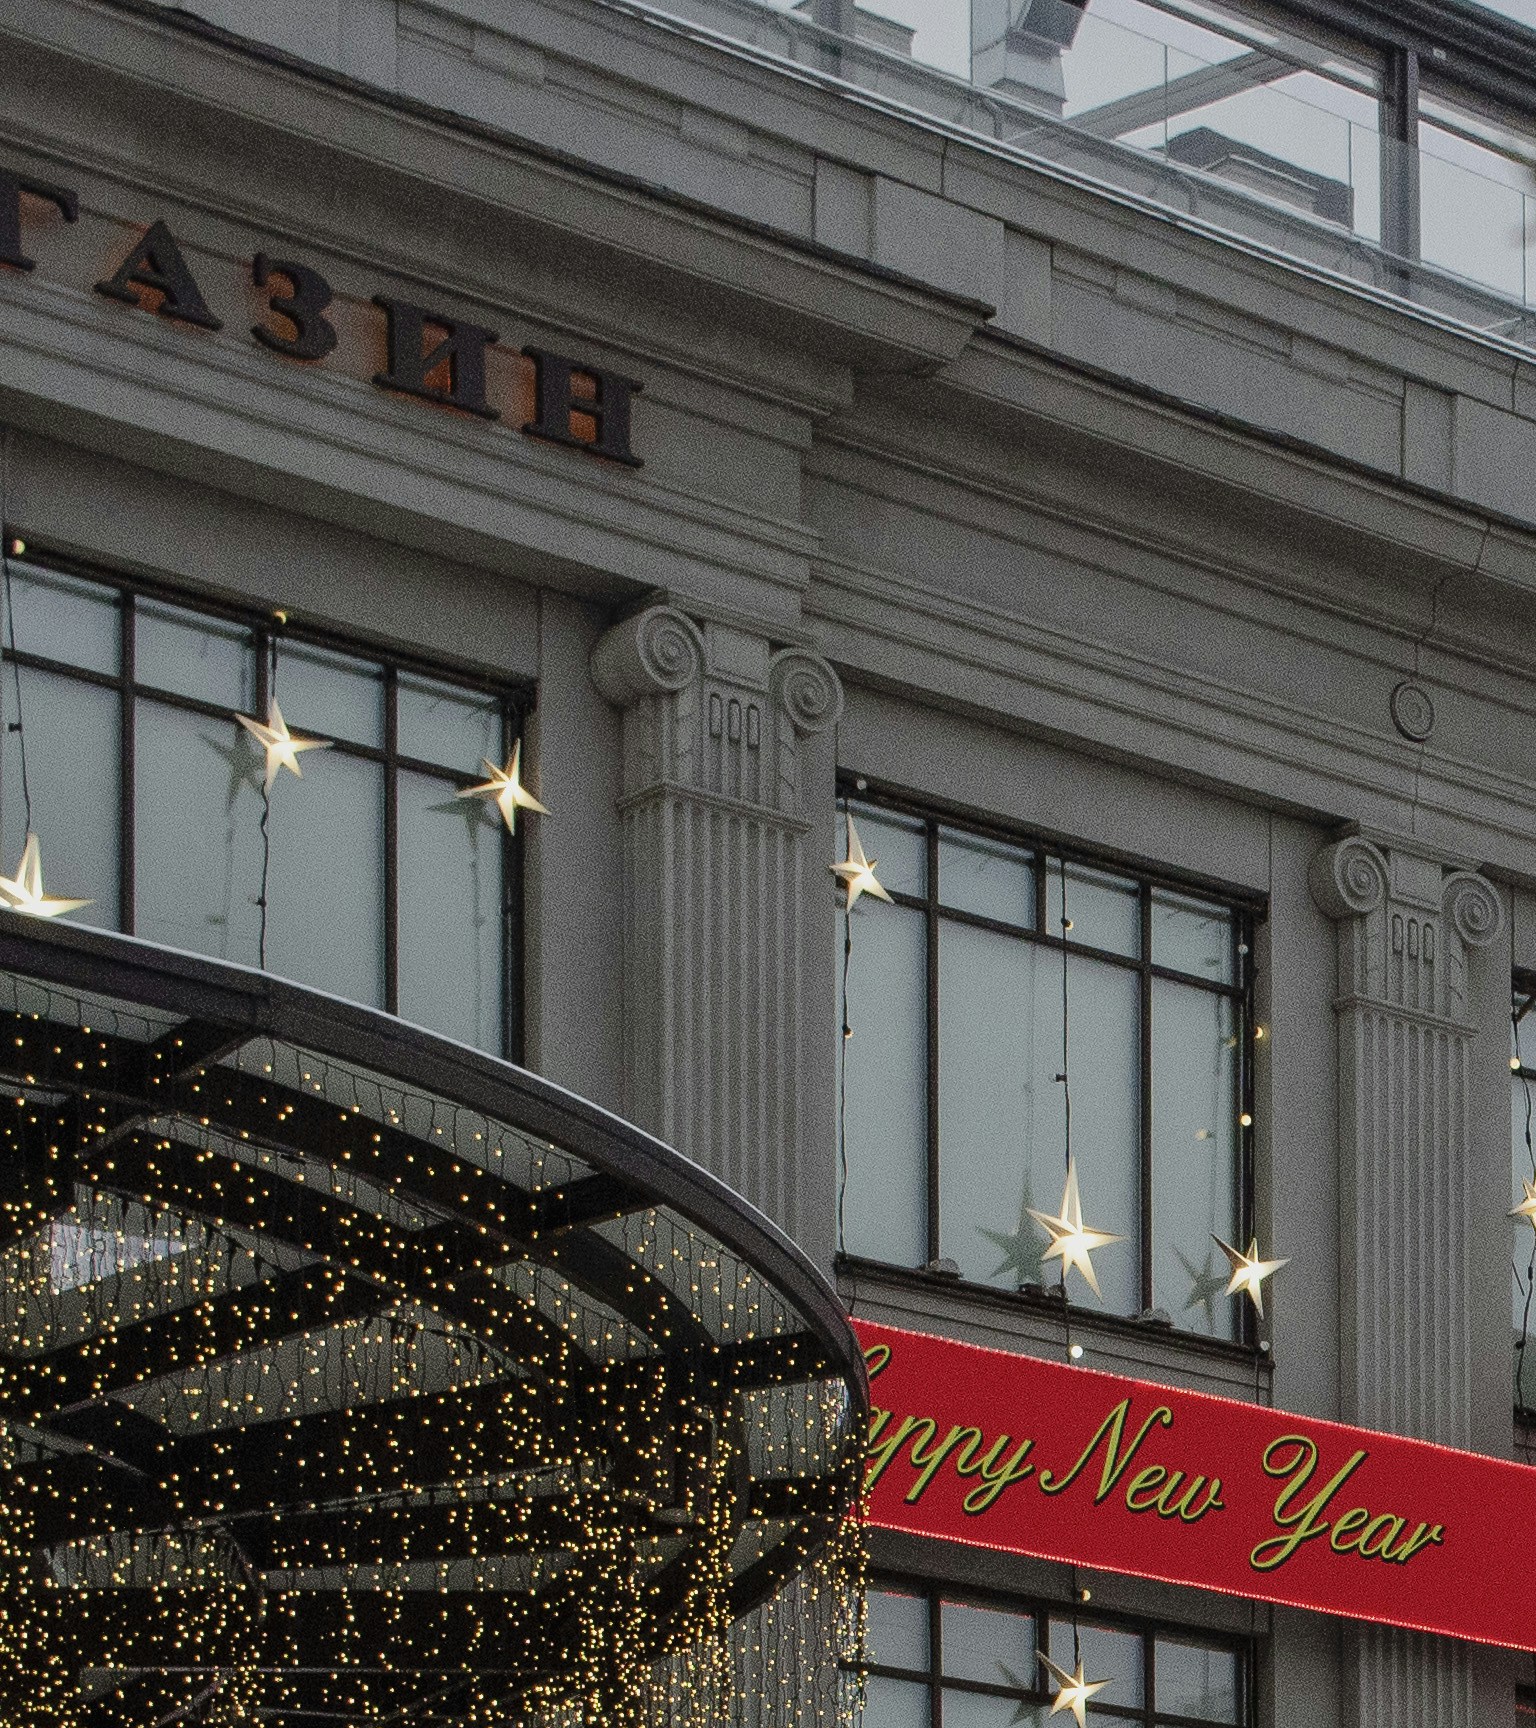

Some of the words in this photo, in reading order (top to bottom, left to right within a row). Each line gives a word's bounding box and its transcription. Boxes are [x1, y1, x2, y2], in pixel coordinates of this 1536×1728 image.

[863, 1344, 1036, 1516] appy
[1040, 1398, 1225, 1524] New
[1250, 1434, 1444, 1572] Year
